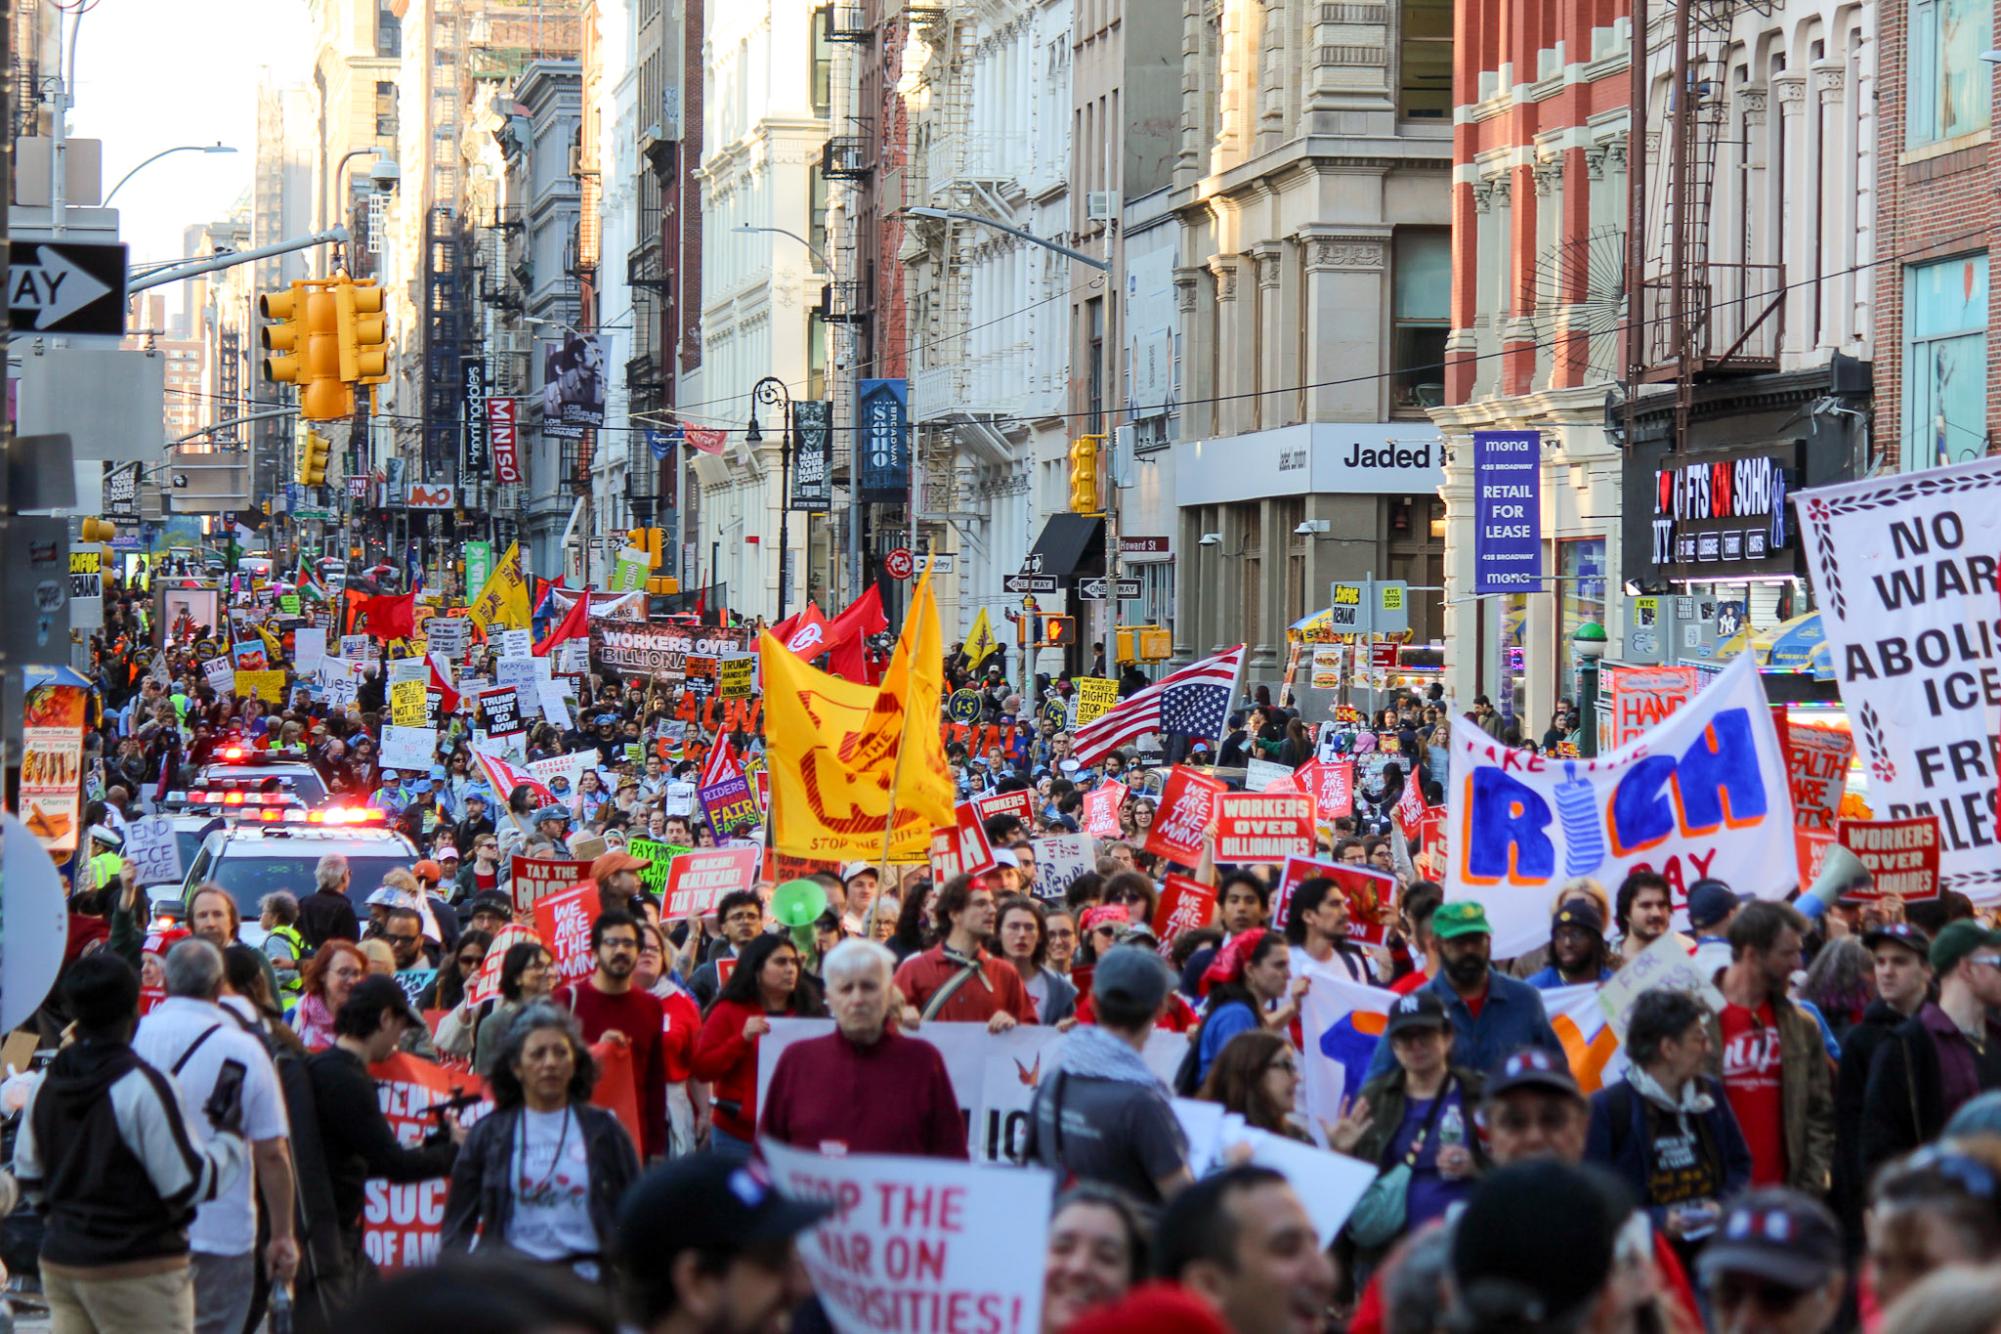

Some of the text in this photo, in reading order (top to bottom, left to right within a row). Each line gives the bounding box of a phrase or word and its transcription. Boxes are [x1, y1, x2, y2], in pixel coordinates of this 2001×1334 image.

[9, 270, 68, 305] AY
[491, 400, 517, 481] MINISO
[872, 405, 888, 467] SOHO
[890, 406, 898, 467] BROADWAY
[799, 451, 825, 460] MAKE
[799, 459, 824, 469] YOUR
[1344, 443, 1430, 468] Jaded
[798, 466, 825, 477] MARK
[798, 472, 824, 484] SOHO
[1483, 485, 1533, 498] RETAIL
[1711, 462, 1732, 518] ON
[1734, 456, 1771, 517] SOHO
[1492, 505, 1524, 519] FOR
[1486, 525, 1530, 539] LEASE
[1889, 511, 1964, 560] NO
[1120, 540, 1156, 551] Howard St
[1011, 580, 1050, 588] ONE WAY
[1090, 585, 1136, 593] ONE WAY
[1872, 555, 1999, 612] WAR
[601, 631, 692, 653] WORKERS
[1845, 619, 2001, 682] ABOLI
[204, 659, 228, 674] EVICT
[723, 659, 750, 670] TRUMP
[480, 692, 517, 707] TRUMP
[1082, 690, 1117, 704] RIGHTS!
[394, 704, 426, 716] NOT THE
[486, 702, 515, 716] MUST
[1080, 702, 1100, 714] STOP
[491, 720, 519, 733] NOW!
[494, 714, 510, 723] GO
[862, 731, 893, 758] THE
[1324, 770, 1341, 779] WE
[703, 779, 746, 801] RIDERS
[1184, 781, 1210, 800] WE
[1321, 786, 1344, 798] THE
[1322, 778, 1345, 790] ARE
[709, 799, 755, 826] FAIR
[982, 795, 1026, 813] WORKERS
[1092, 803, 1109, 813] ARE
[1175, 796, 1210, 817] ARE
[1223, 799, 1309, 818] WORKERS
[1091, 810, 1111, 824] THE
[1170, 805, 1205, 831] THE
[131, 820, 169, 841] END
[1234, 821, 1298, 835] OVER
[1848, 824, 1934, 850] WORKERS
[631, 842, 653, 857] PAY
[810, 836, 848, 850] STOP
[1222, 837, 1310, 857] BILLIONAIRES
[130, 844, 173, 866] ICE
[1860, 852, 1924, 870] OVER
[142, 862, 175, 879] AGE
[525, 864, 578, 879] TAX THE
[678, 868, 742, 889] HEALTHCARE!
[554, 899, 581, 918] WE
[670, 892, 692, 913] TAX
[1177, 891, 1202, 911] WE
[555, 916, 590, 938] ARE
[1171, 909, 1202, 928] ARE
[554, 933, 592, 955] THE
[874, 1180, 968, 1232] THE
[364, 1230, 397, 1265] OF
[885, 1235, 946, 1282] ON
